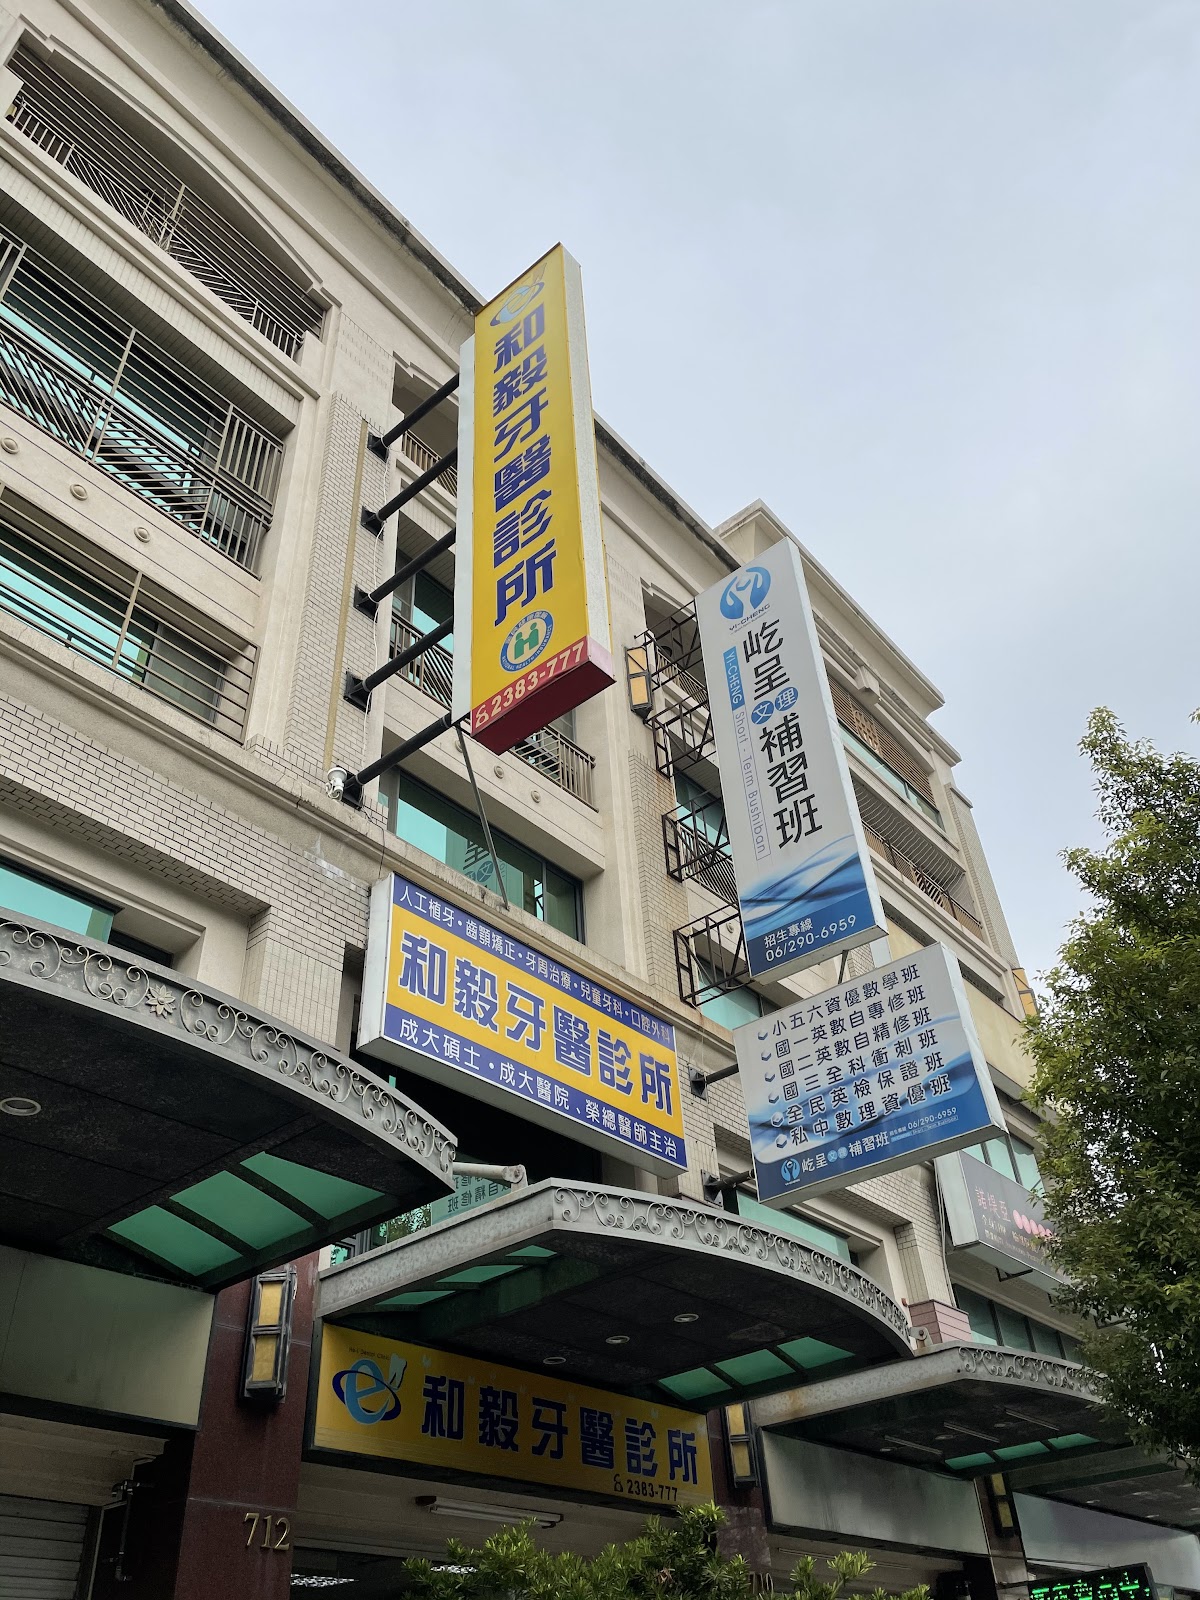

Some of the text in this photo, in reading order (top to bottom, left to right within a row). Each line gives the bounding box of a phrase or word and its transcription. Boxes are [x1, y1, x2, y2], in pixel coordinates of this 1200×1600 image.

[493, 302, 557, 627] 和毅牙醫診所
[491, 640, 585, 717] 2383-777
[725, 651, 743, 704] YI-CHENG
[735, 711, 748, 743] Short
[742, 755, 753, 787] Term
[748, 790, 766, 854] Bushiban
[764, 918, 813, 948] 招生專線
[765, 914, 856, 962] 06/290-6959
[398, 930, 674, 1117] 和毅牙醫診所
[772, 963, 921, 1036] 小五六資優數學班
[775, 984, 926, 1058] 國一英數自專修班
[779, 1006, 932, 1080] 國二英數自精修班
[783, 1028, 938, 1101] 國三全科衝刺班
[787, 1051, 945, 1126] 全民英檢保證班
[790, 1074, 952, 1147] 私中數理資優班
[907, 1106, 957, 1130] 06/290-6959
[421, 1375, 698, 1485] 和毅牙醫診所
[627, 1479, 678, 1502] 2383-777
[244, 1512, 291, 1551] 712
